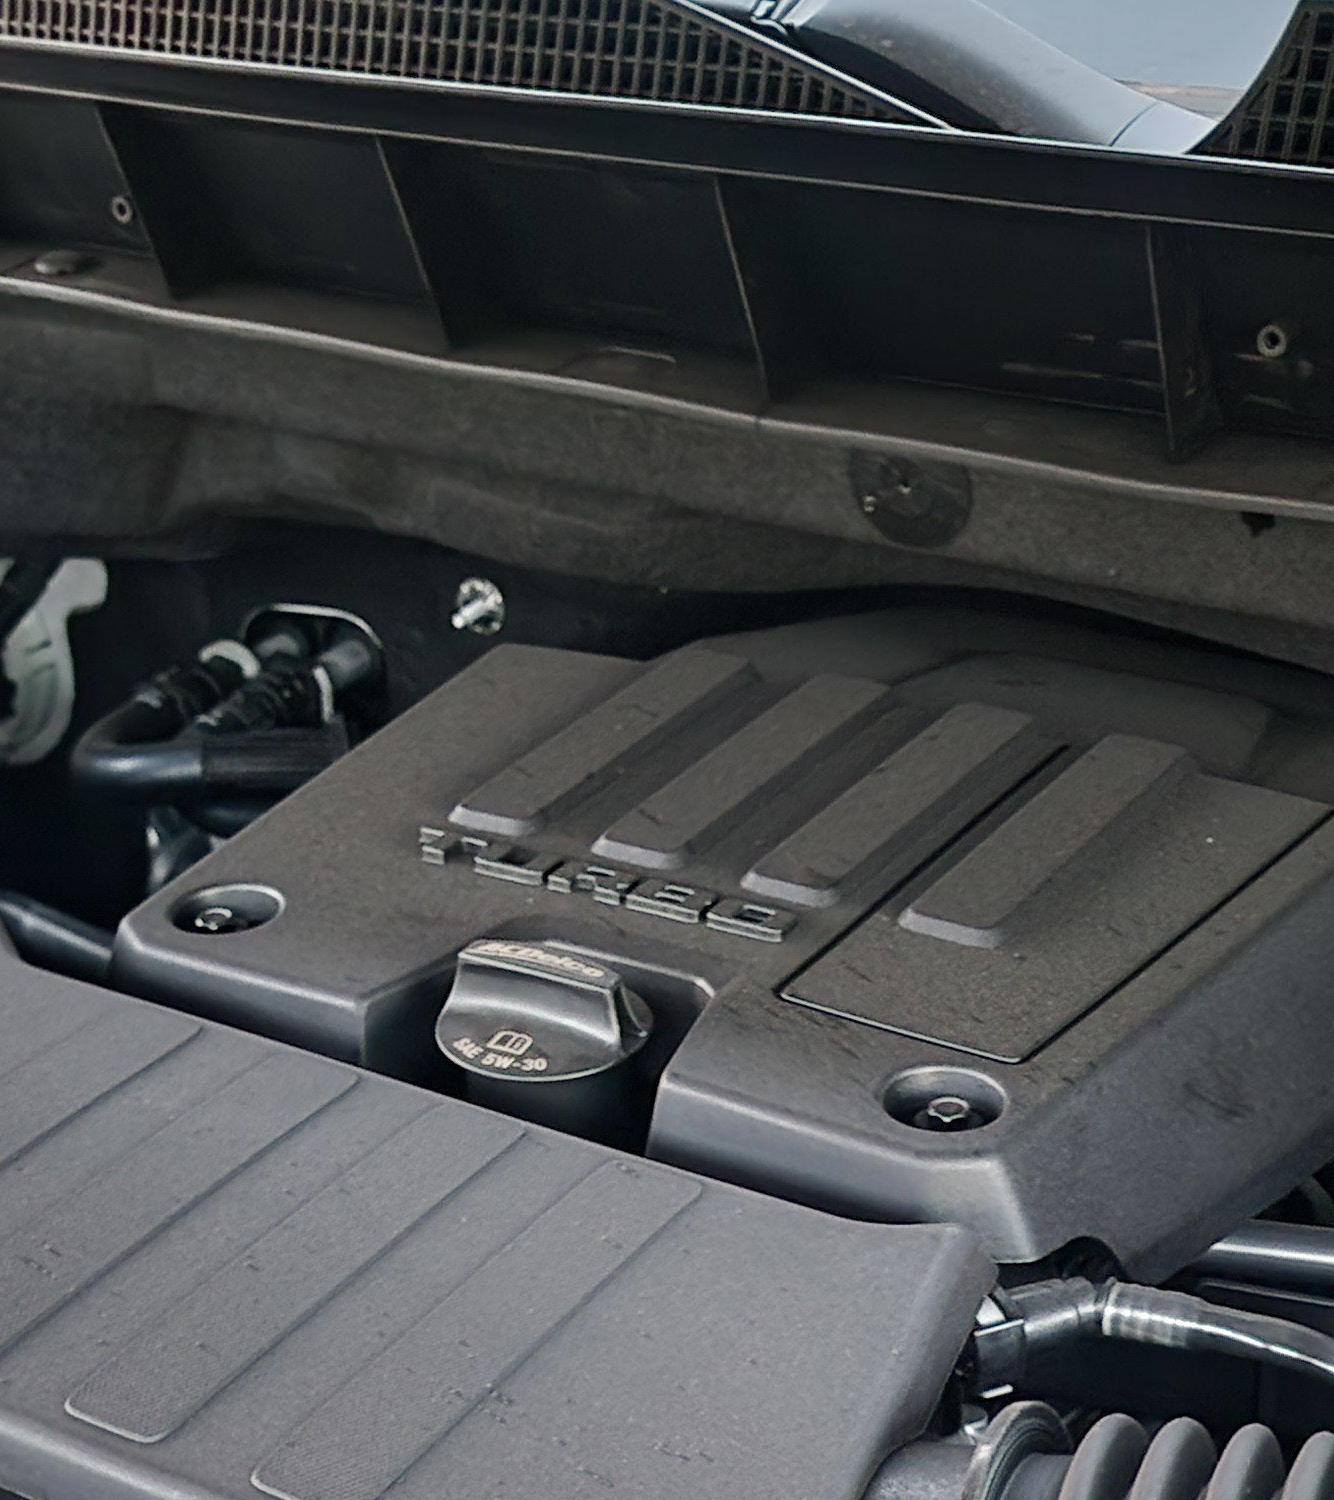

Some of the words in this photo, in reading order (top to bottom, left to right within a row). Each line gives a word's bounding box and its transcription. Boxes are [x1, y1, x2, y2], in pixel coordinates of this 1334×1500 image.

[471, 944, 606, 979] ACDelco
[452, 1036, 482, 1060] SAE
[481, 1053, 549, 1073] 5W-30
